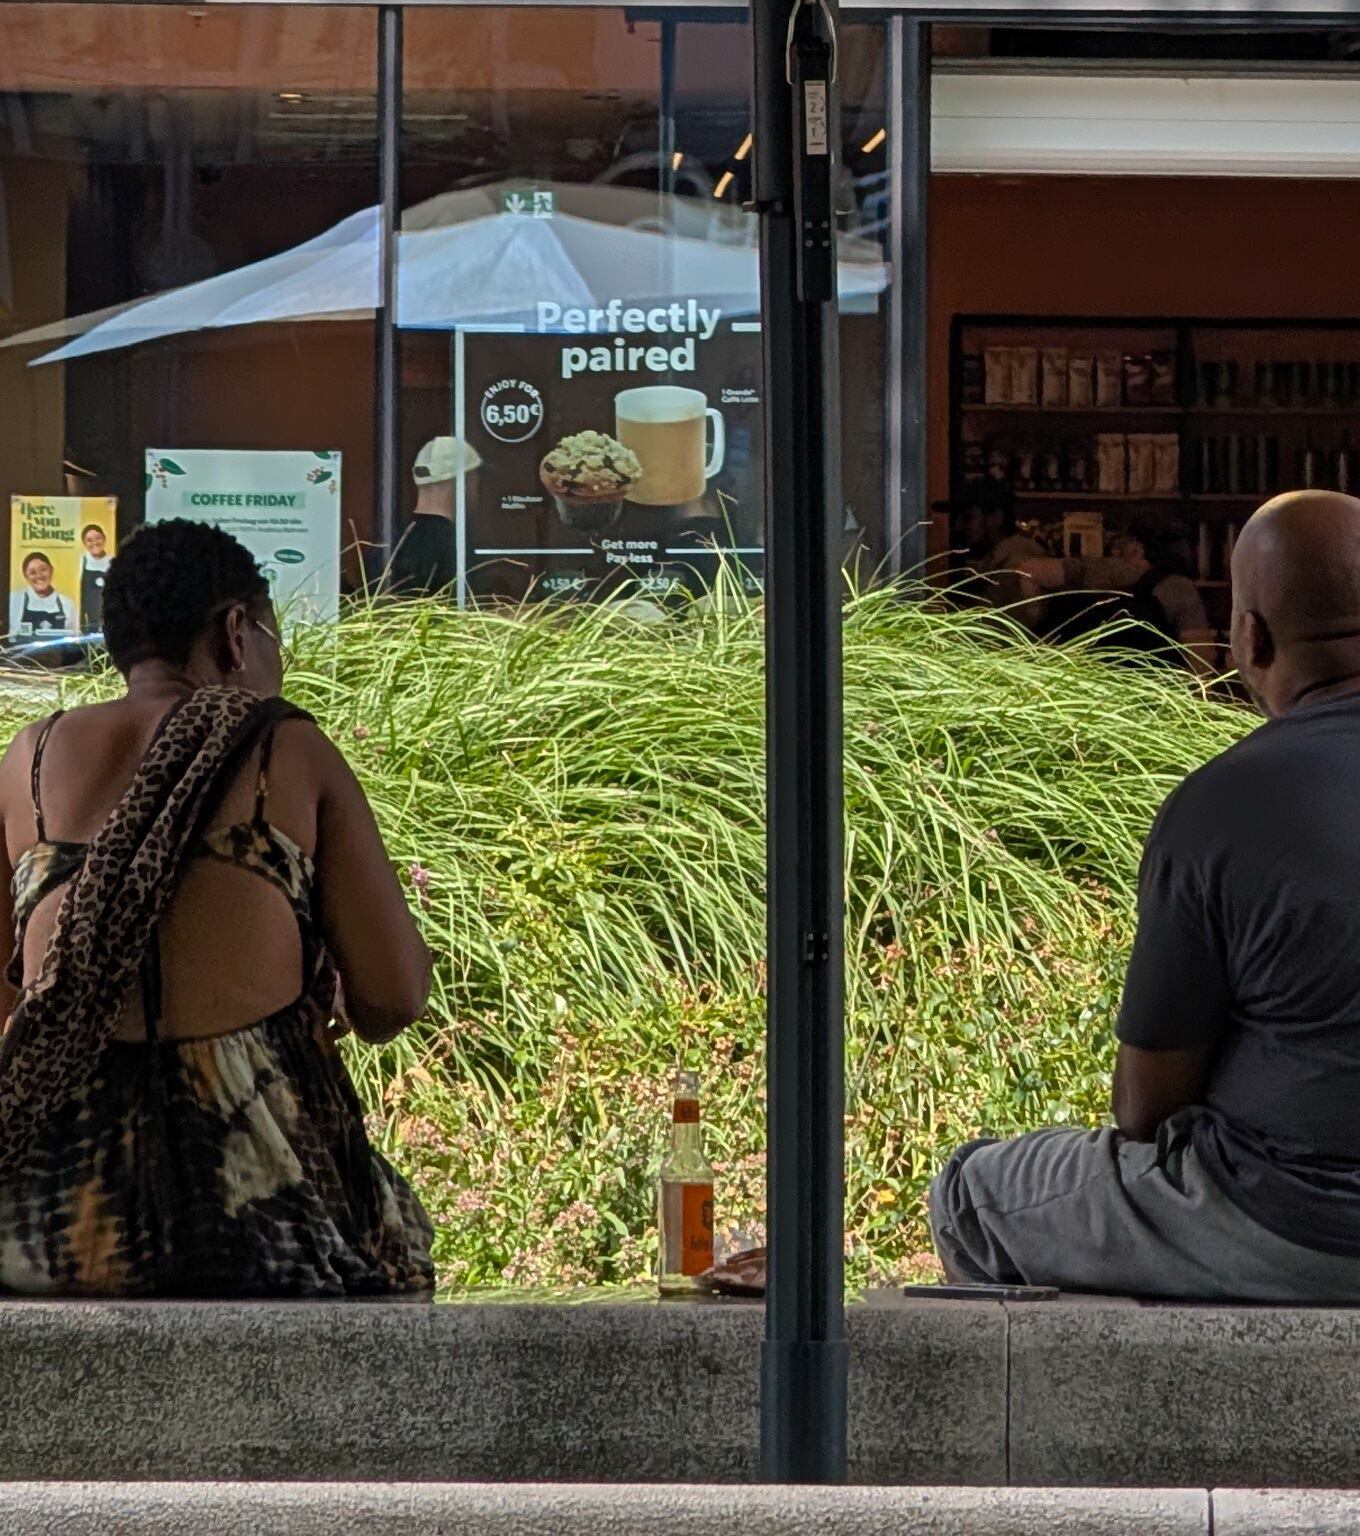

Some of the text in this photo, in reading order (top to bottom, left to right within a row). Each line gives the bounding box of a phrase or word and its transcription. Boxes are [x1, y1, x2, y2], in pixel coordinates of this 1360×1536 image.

[536, 299, 722, 340] Perfectly
[561, 337, 696, 379] paired
[485, 379, 540, 399] ENJOY FOR
[191, 493, 297, 507] COFFEE FRIDAY
[21, 502, 56, 521] Here
[34, 516, 61, 528] you
[21, 522, 75, 543] Belong
[601, 538, 658, 550] Get more
[606, 552, 654, 564] Pay less
